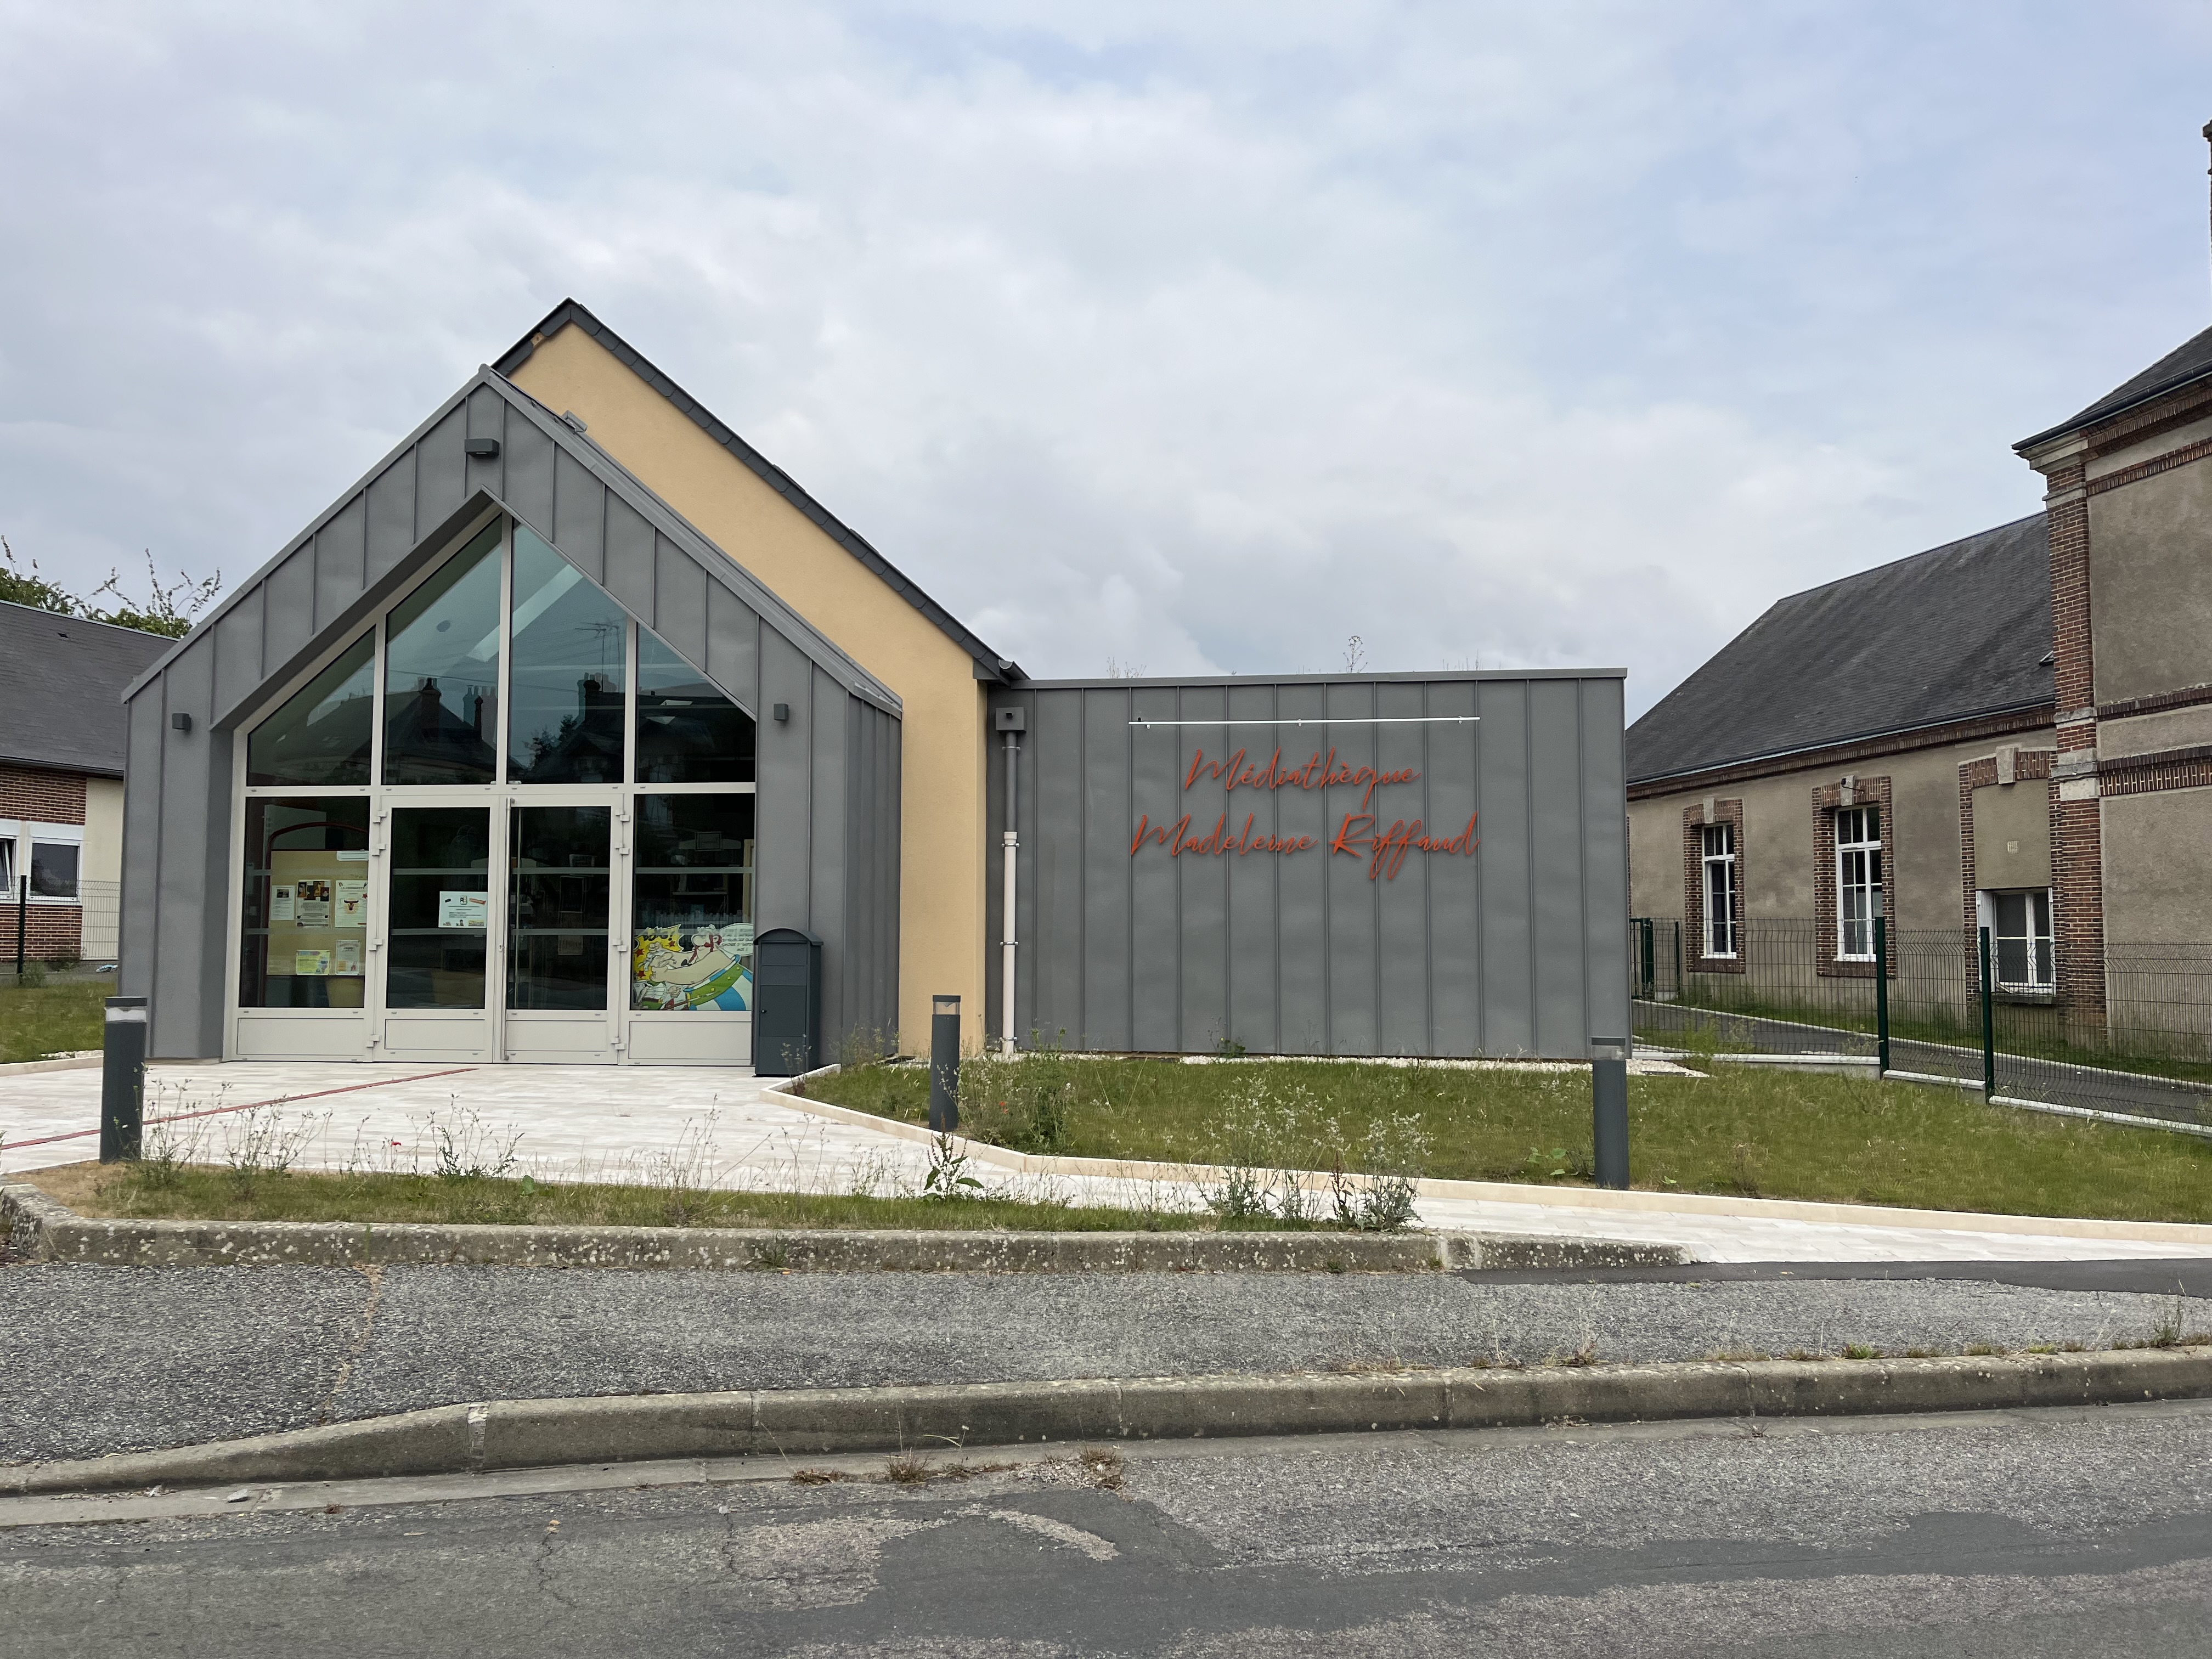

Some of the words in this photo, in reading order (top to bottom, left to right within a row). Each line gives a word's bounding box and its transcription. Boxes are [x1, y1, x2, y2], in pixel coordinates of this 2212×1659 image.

[1185, 746, 1421, 810] Médiathèque
[1131, 812, 1318, 856] Madeleine
[1329, 811, 1480, 879] Riffaud
